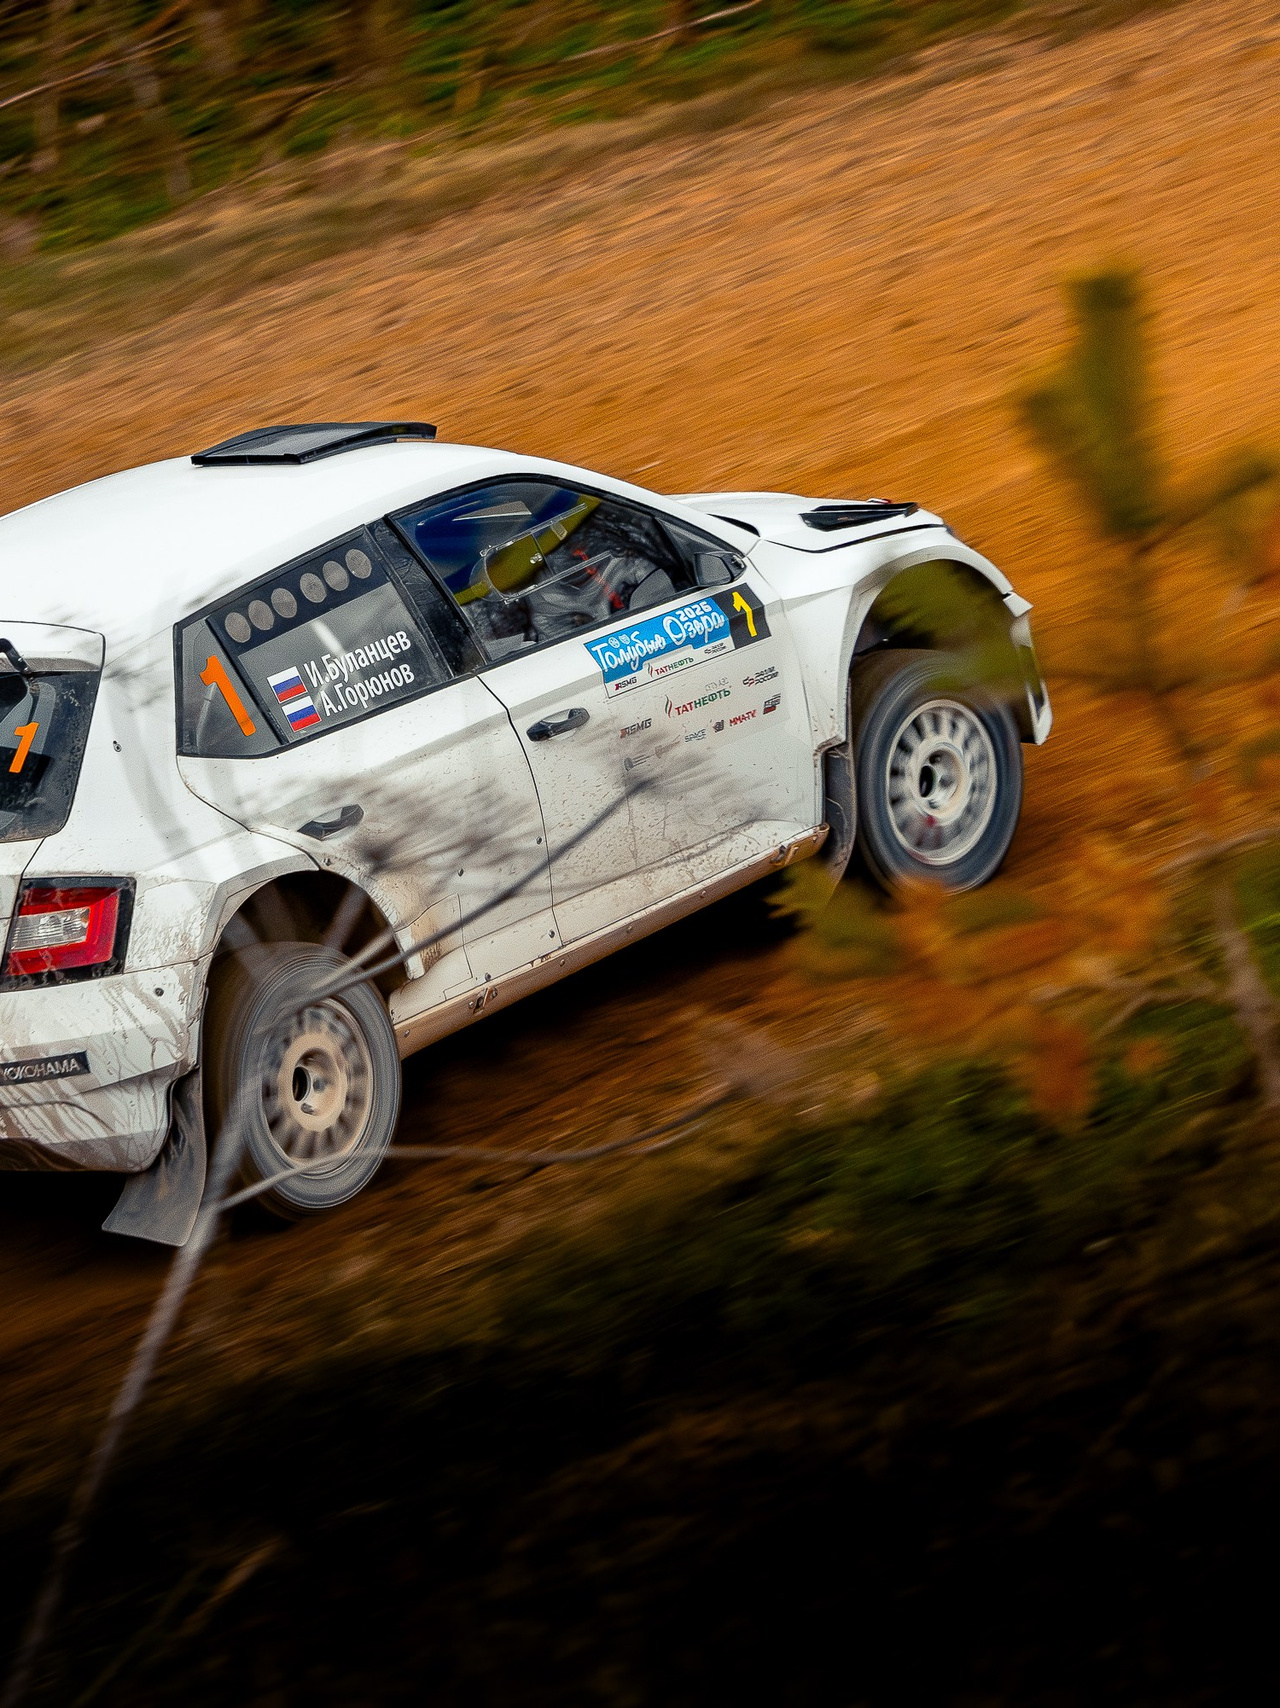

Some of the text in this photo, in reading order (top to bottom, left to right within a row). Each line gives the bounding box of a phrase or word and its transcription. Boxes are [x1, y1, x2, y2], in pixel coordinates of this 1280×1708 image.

[676, 602, 713, 620] 2026
[731, 591, 758, 637] 1
[303, 630, 411, 688] И.Буланцев
[654, 656, 694, 675] ТАТНЕФТЬ
[200, 655, 257, 737] 1
[320, 663, 415, 717] А.Горюнов
[675, 688, 731, 716] ТАТНЕФТЬ
[8, 722, 39, 774] 1
